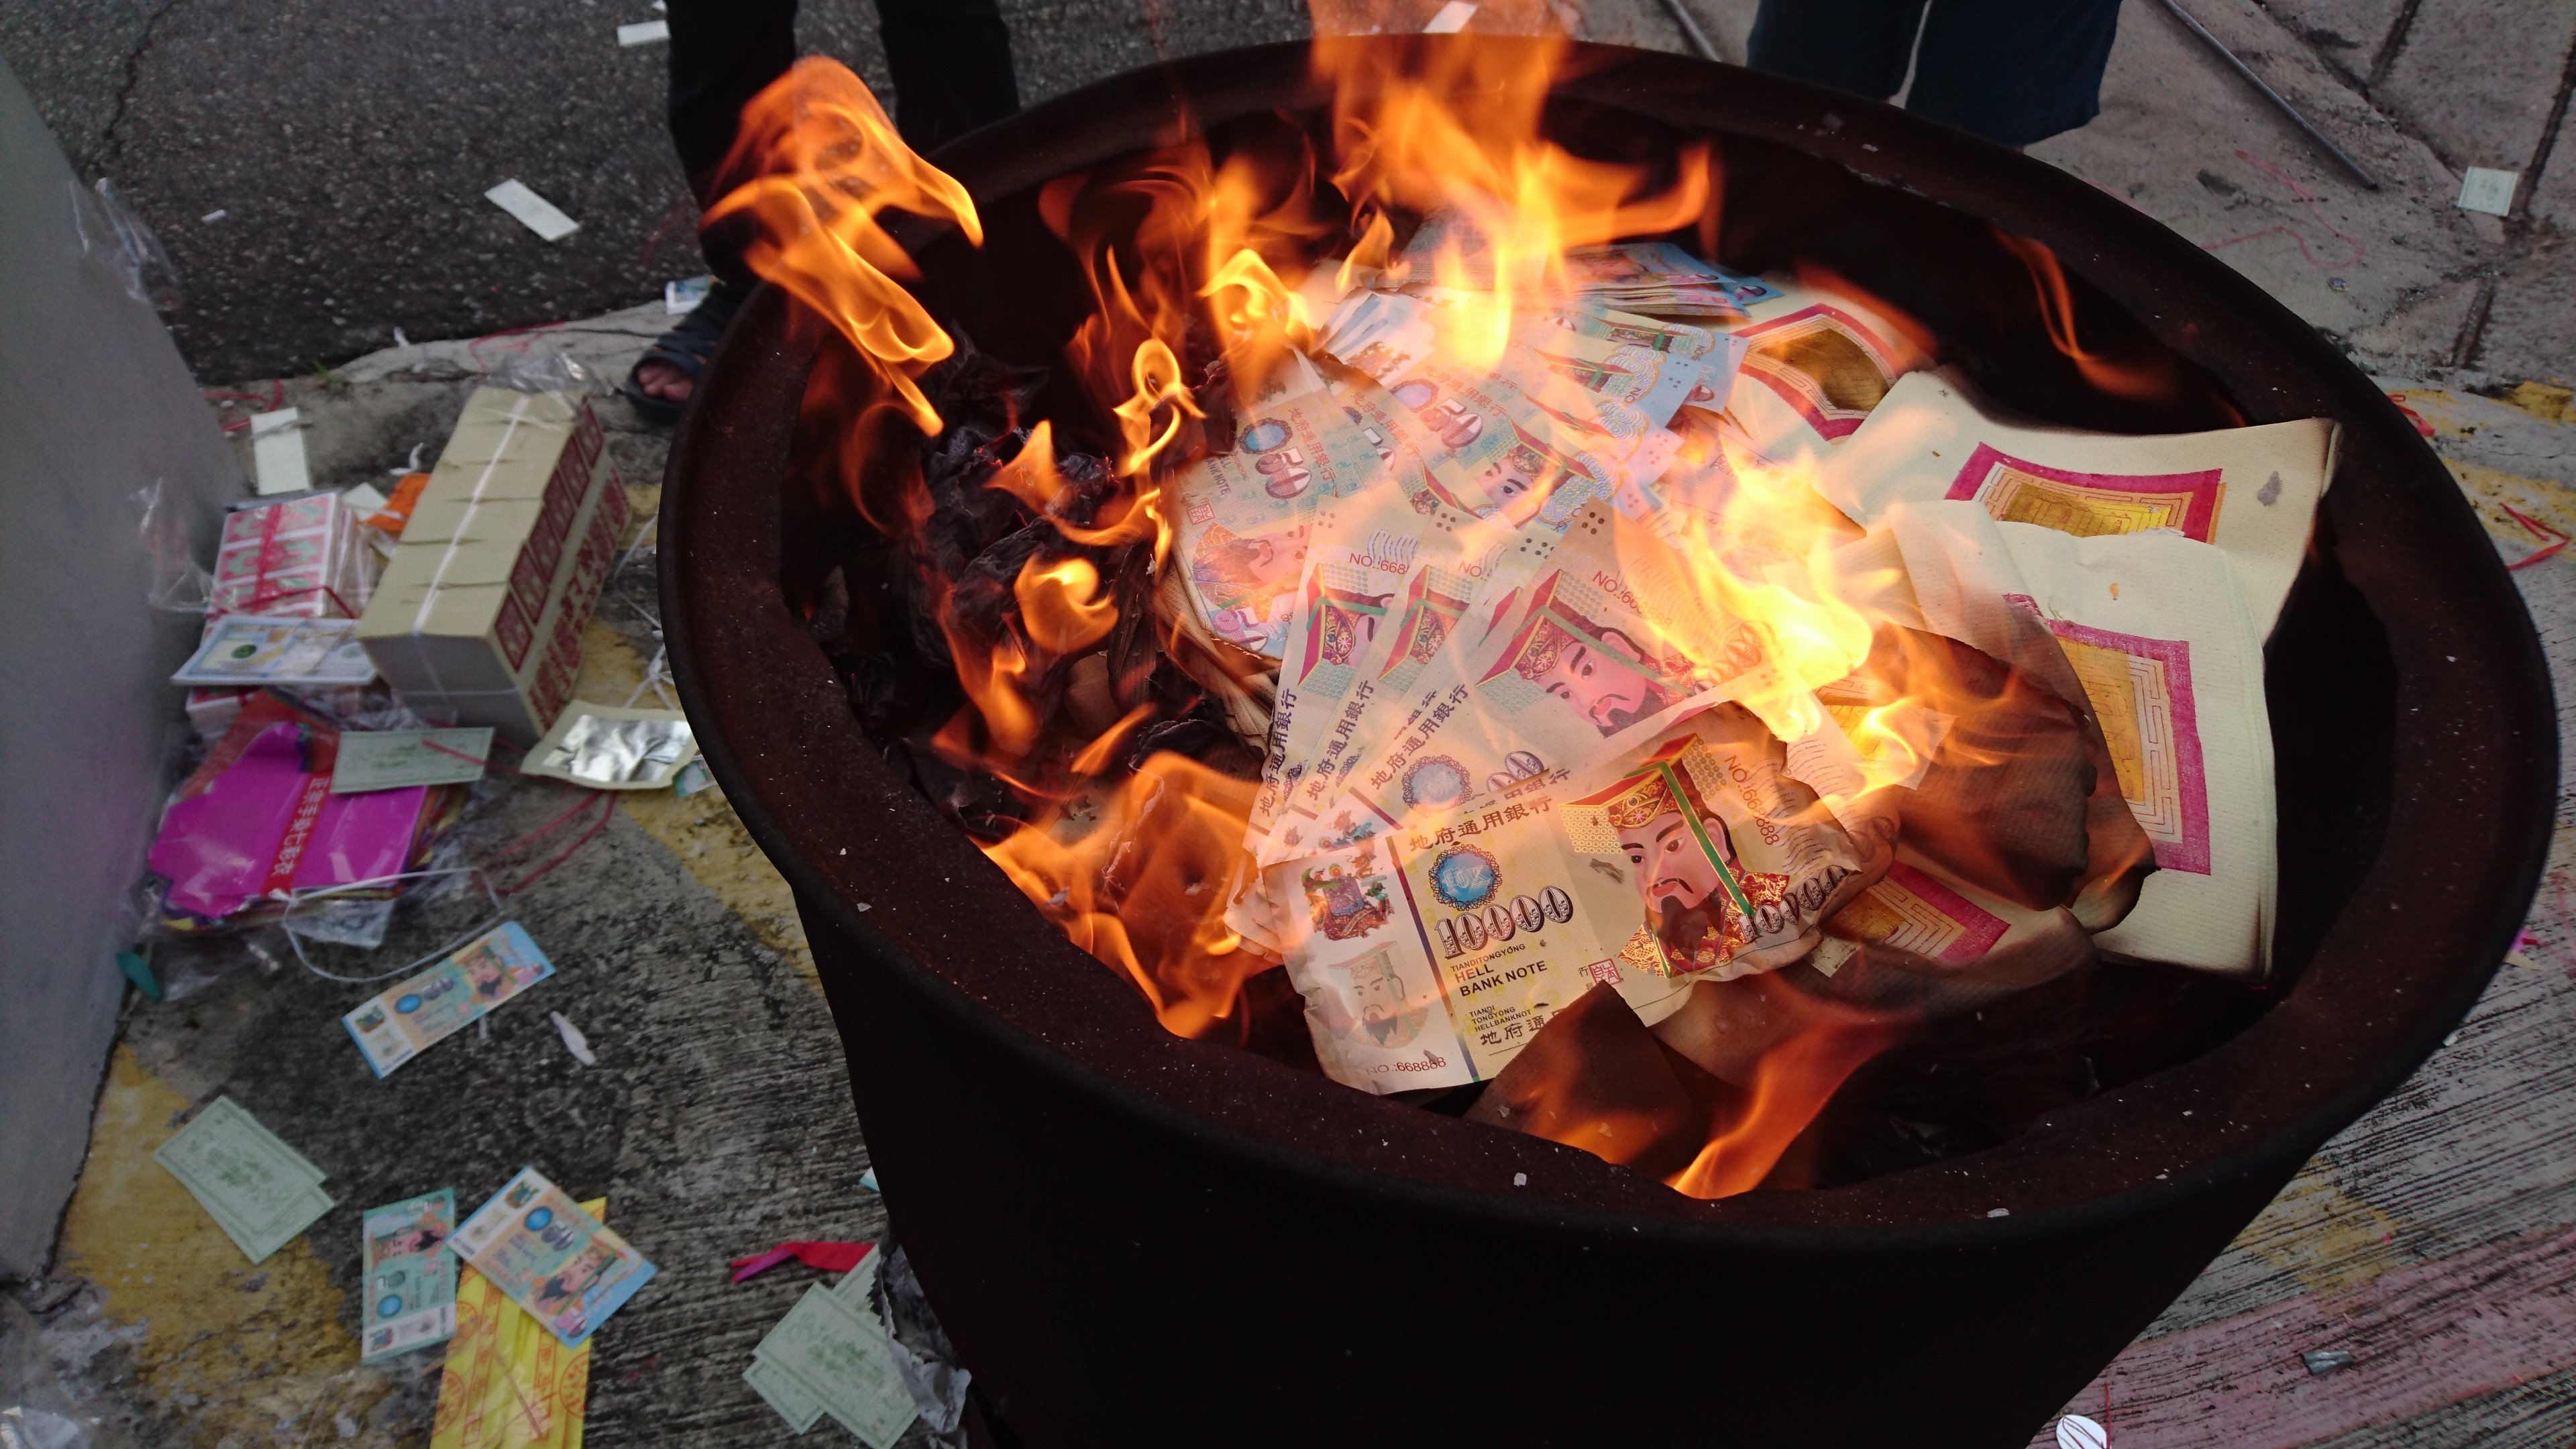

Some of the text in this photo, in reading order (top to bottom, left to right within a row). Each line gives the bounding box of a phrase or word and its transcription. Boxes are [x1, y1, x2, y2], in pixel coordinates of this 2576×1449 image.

[1255, 446, 1313, 499] 50
[1306, 680, 1375, 801] 地府通用銀行
[1371, 684, 1469, 790] 地府通用銀行
[1409, 796, 1552, 852] 地府通用銀行
[1434, 885, 1574, 960] 10000
[1454, 964, 1495, 983] HELL
[1460, 961, 1548, 997] BANK NOTE
[1469, 1005, 1495, 1017] TIANDI
[1472, 1006, 1516, 1024] TONGYONG
[1474, 1009, 1532, 1032] HELLBANKNOT
